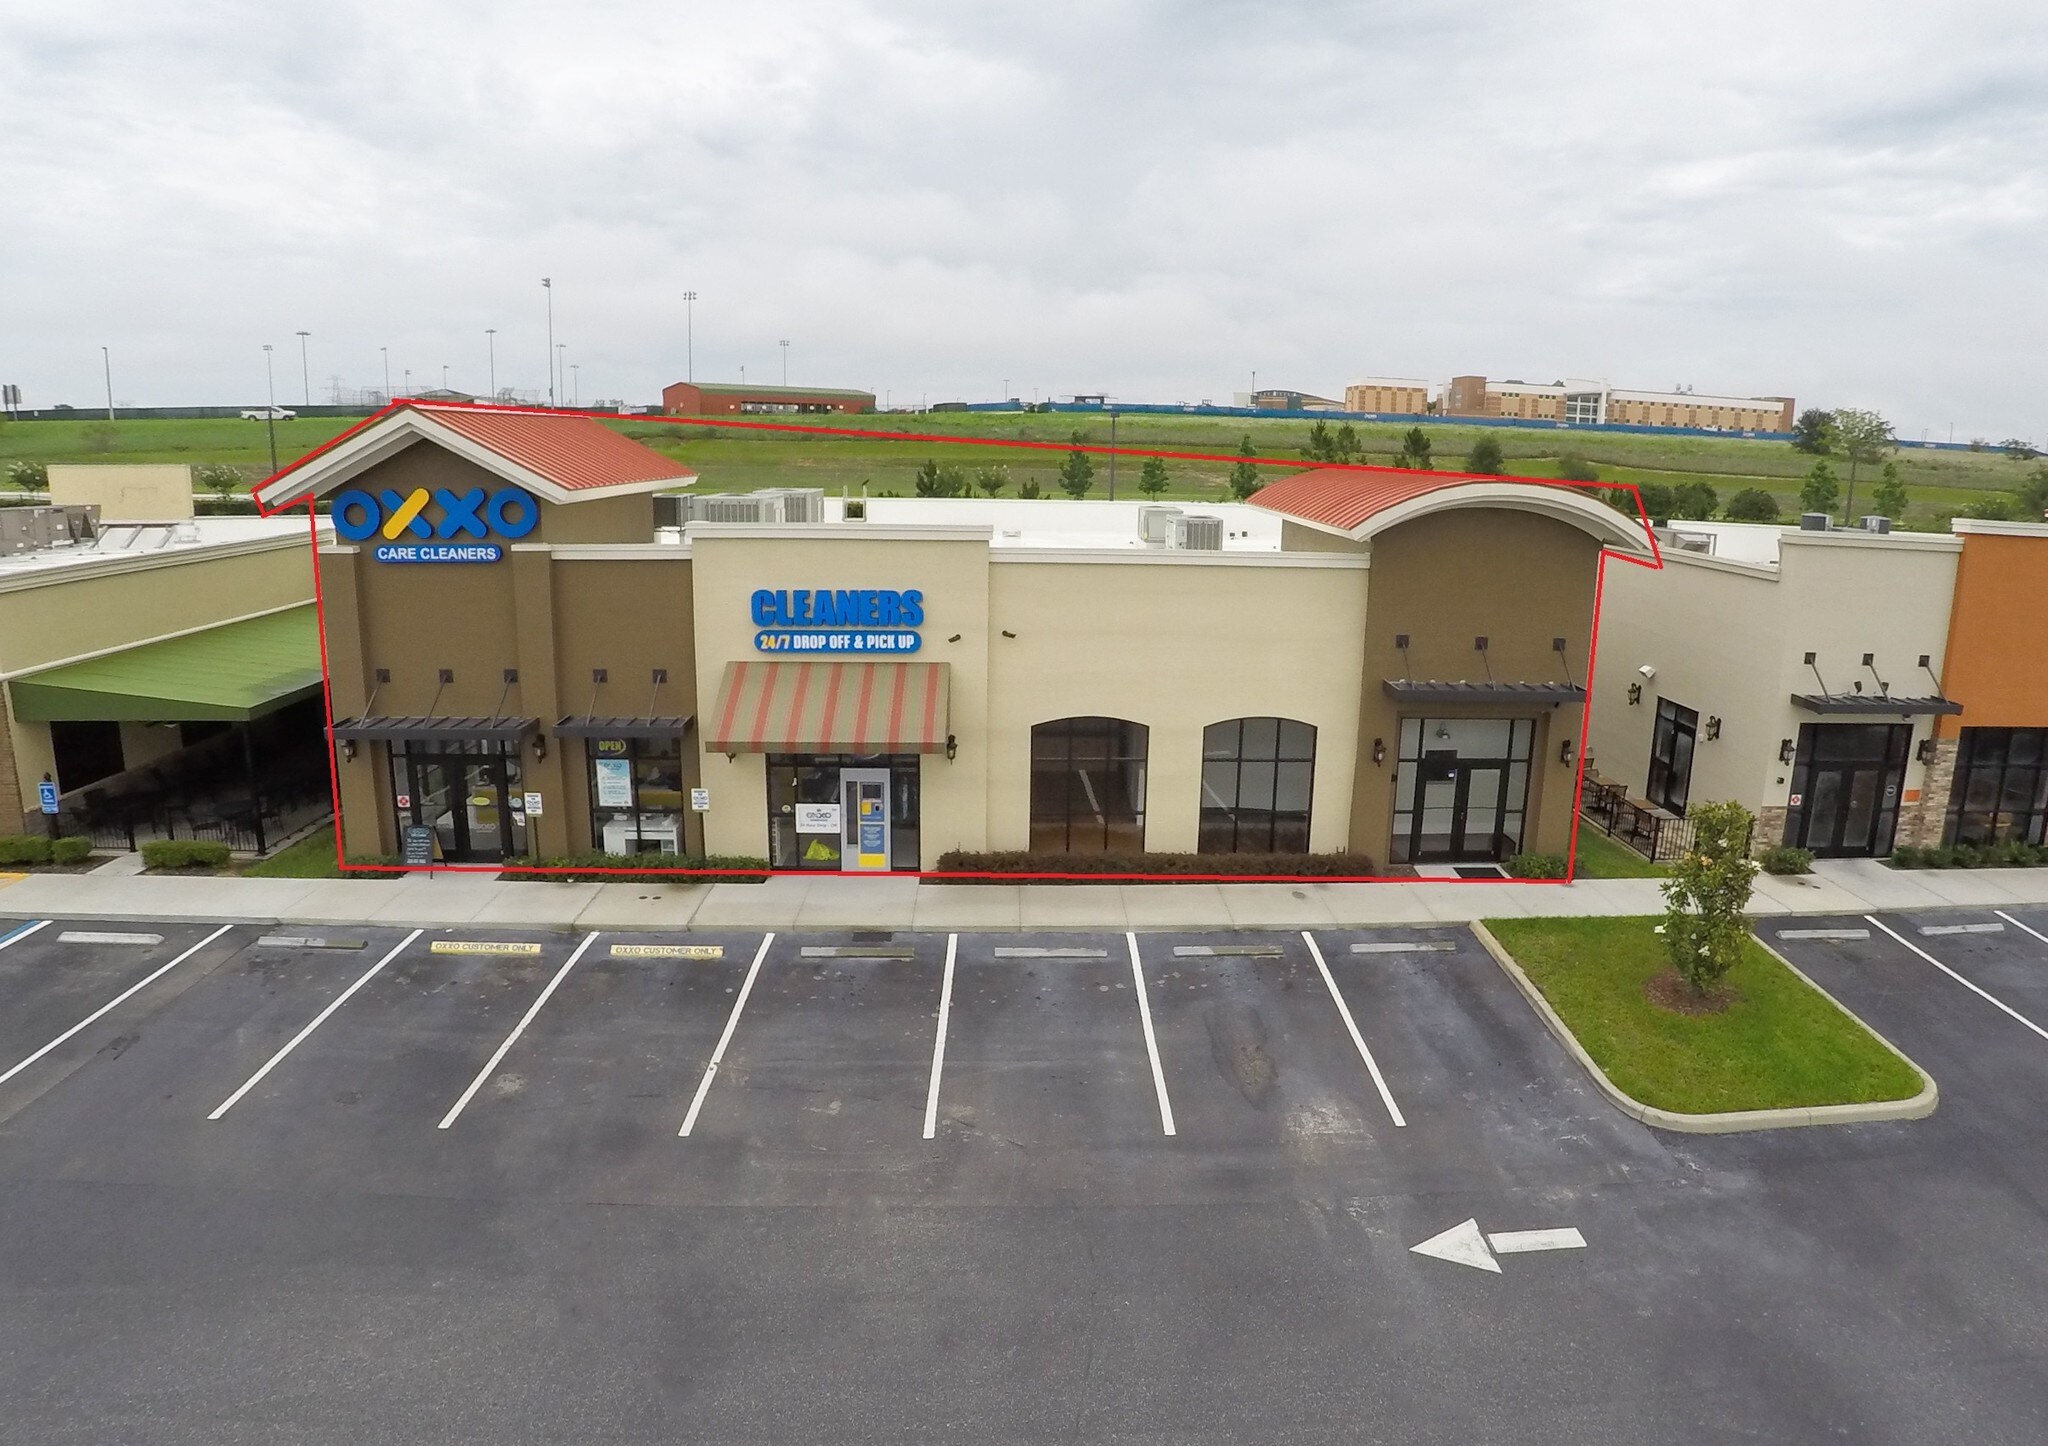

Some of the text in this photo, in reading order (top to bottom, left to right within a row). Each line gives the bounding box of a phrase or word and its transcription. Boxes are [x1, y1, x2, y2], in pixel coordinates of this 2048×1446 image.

[331, 487, 538, 541] OXXO
[377, 547, 497, 560] CARE CLEANERS
[751, 589, 925, 628] CLEANERS
[760, 634, 915, 650] 24/7 DROP OFF & PICK UP
[598, 740, 622, 751] OPEN
[435, 942, 534, 953] OXXO CUSTOMER ONLY
[615, 946, 716, 956] OXXO CUSTOMER ONLY
